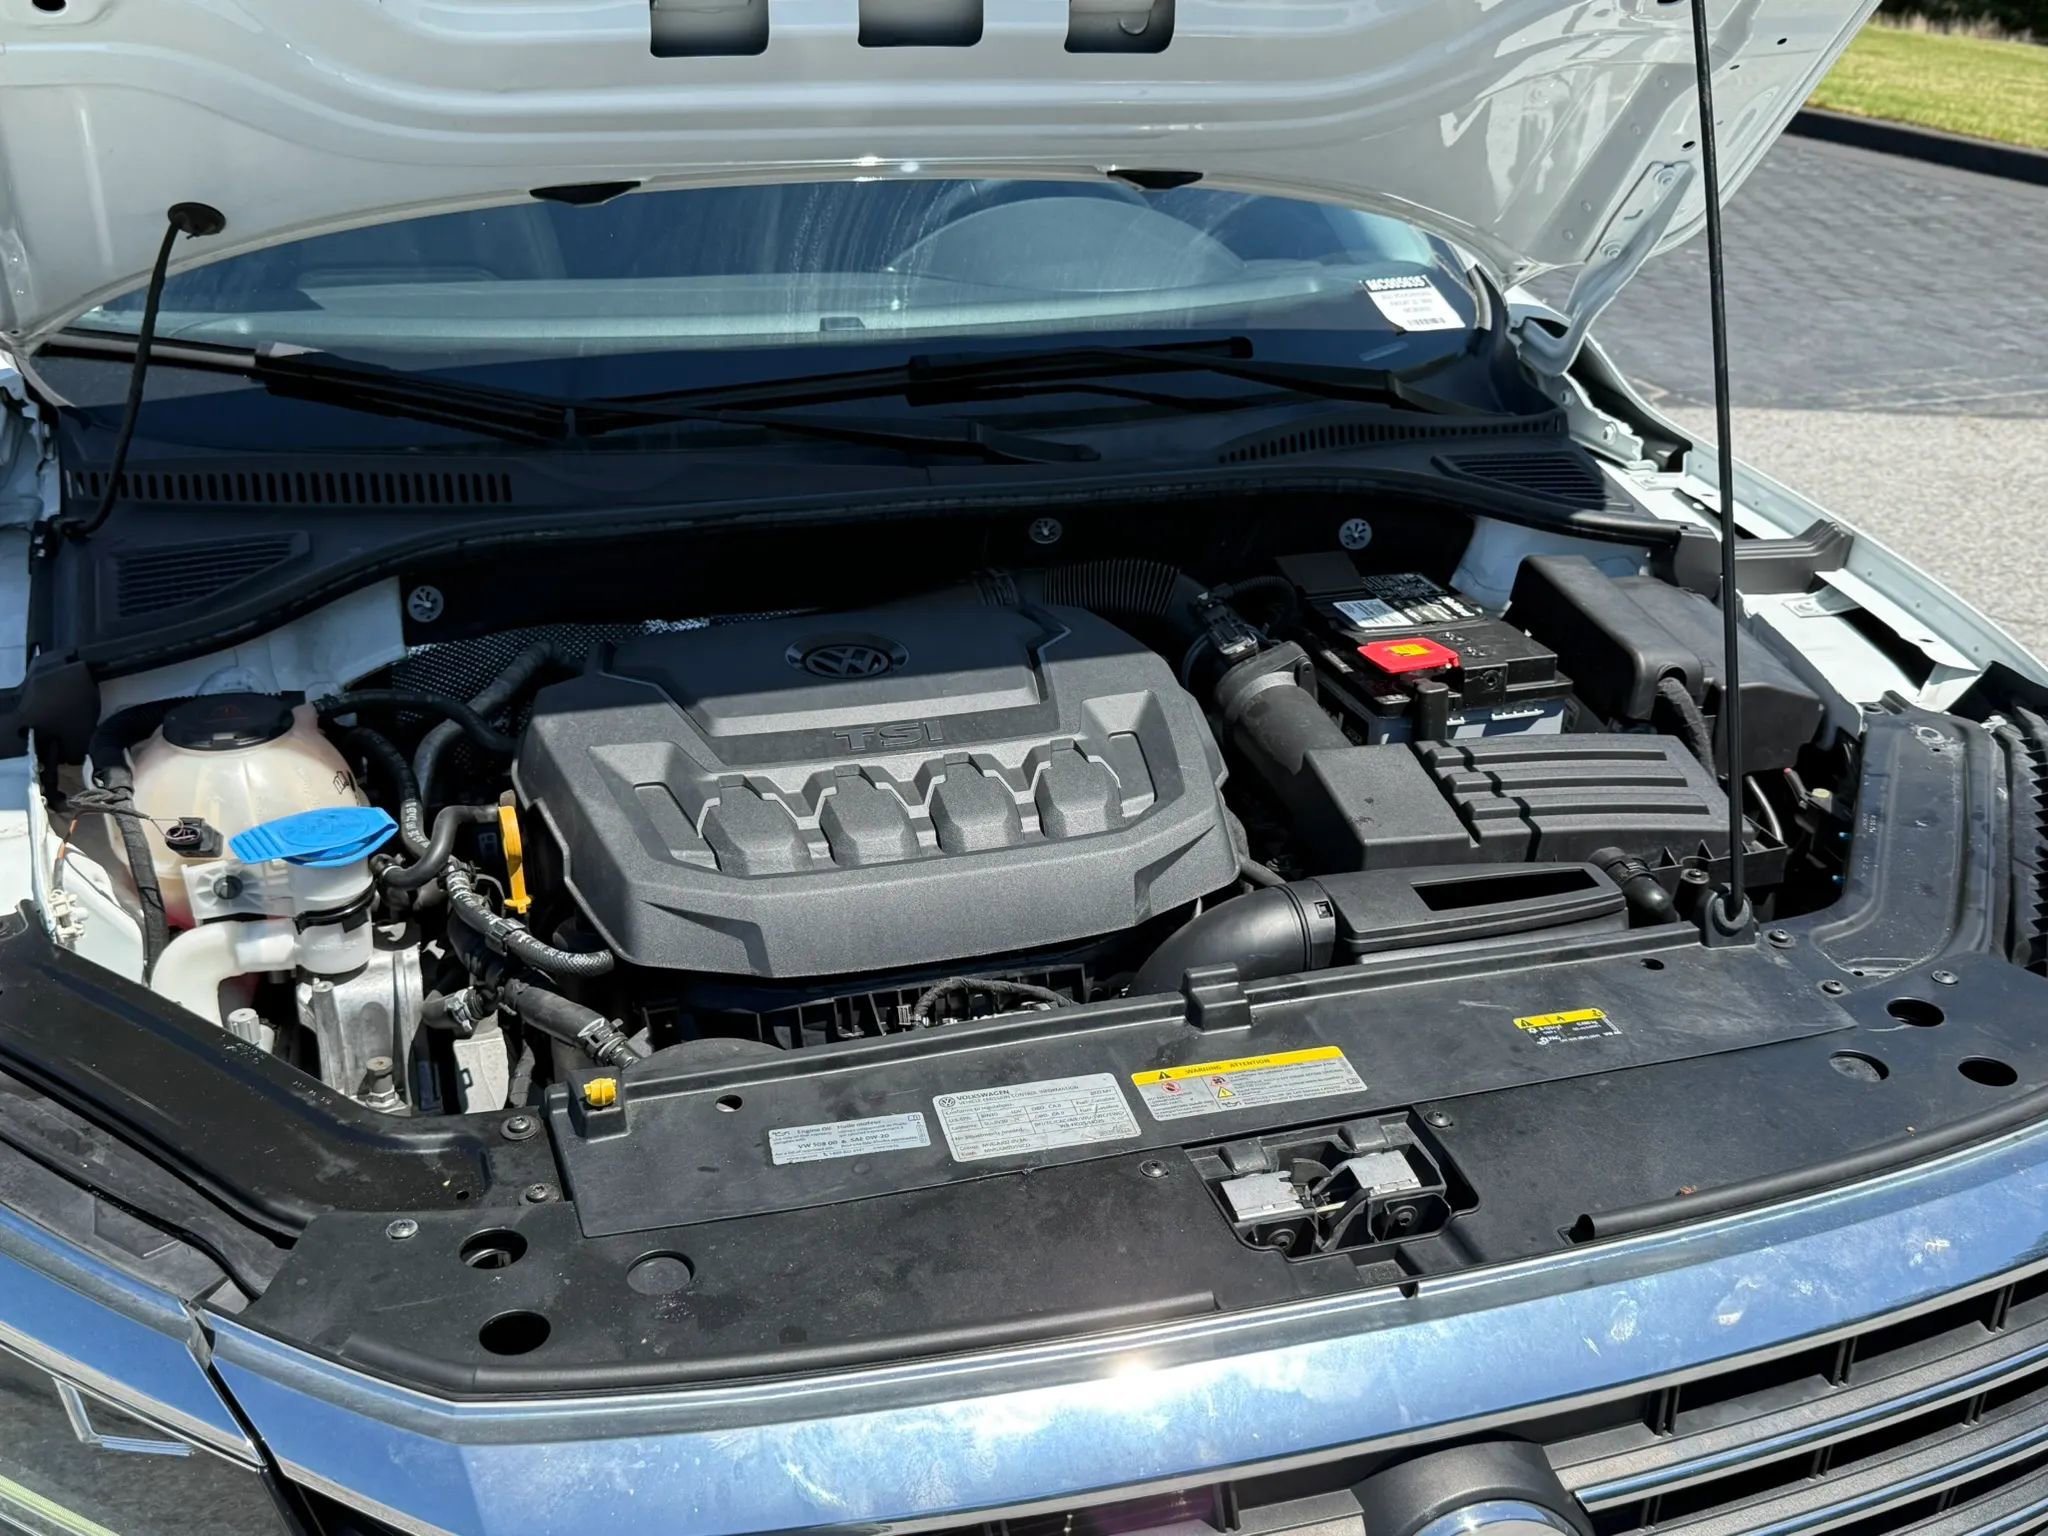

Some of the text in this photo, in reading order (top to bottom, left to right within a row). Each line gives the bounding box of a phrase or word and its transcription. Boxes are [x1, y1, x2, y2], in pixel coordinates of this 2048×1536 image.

[832, 719, 944, 751] TSI
[1228, 1058, 1270, 1068] ATTENTION
[955, 1089, 1009, 1101] VOLKSWAGEN
